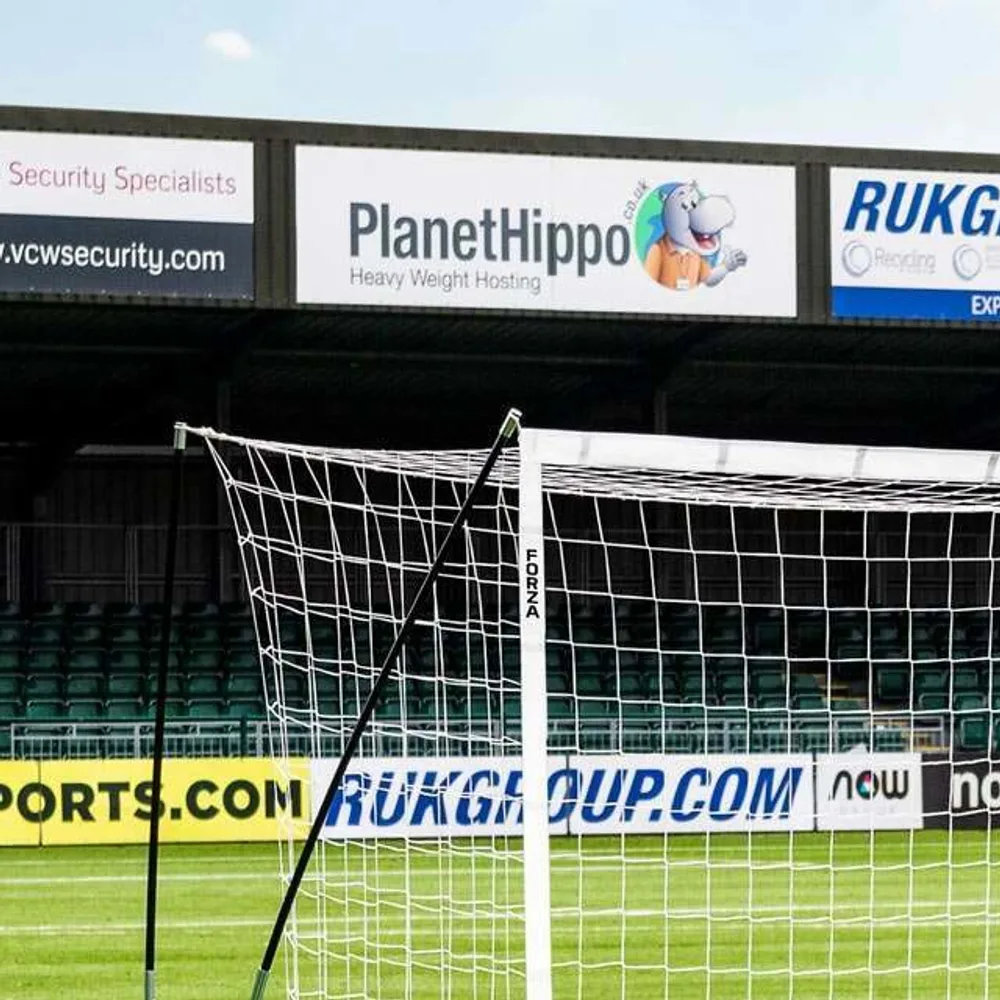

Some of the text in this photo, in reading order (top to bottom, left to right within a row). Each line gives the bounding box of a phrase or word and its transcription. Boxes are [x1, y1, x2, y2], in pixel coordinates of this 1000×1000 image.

[9, 161, 237, 196] Security Specialists
[349, 202, 630, 277] PlanetHippo
[875, 248, 936, 270] Recycling
[350, 267, 541, 295] Heavy Weight Hosting
[526, 549, 539, 619] FORZA
[829, 770, 909, 800] now
